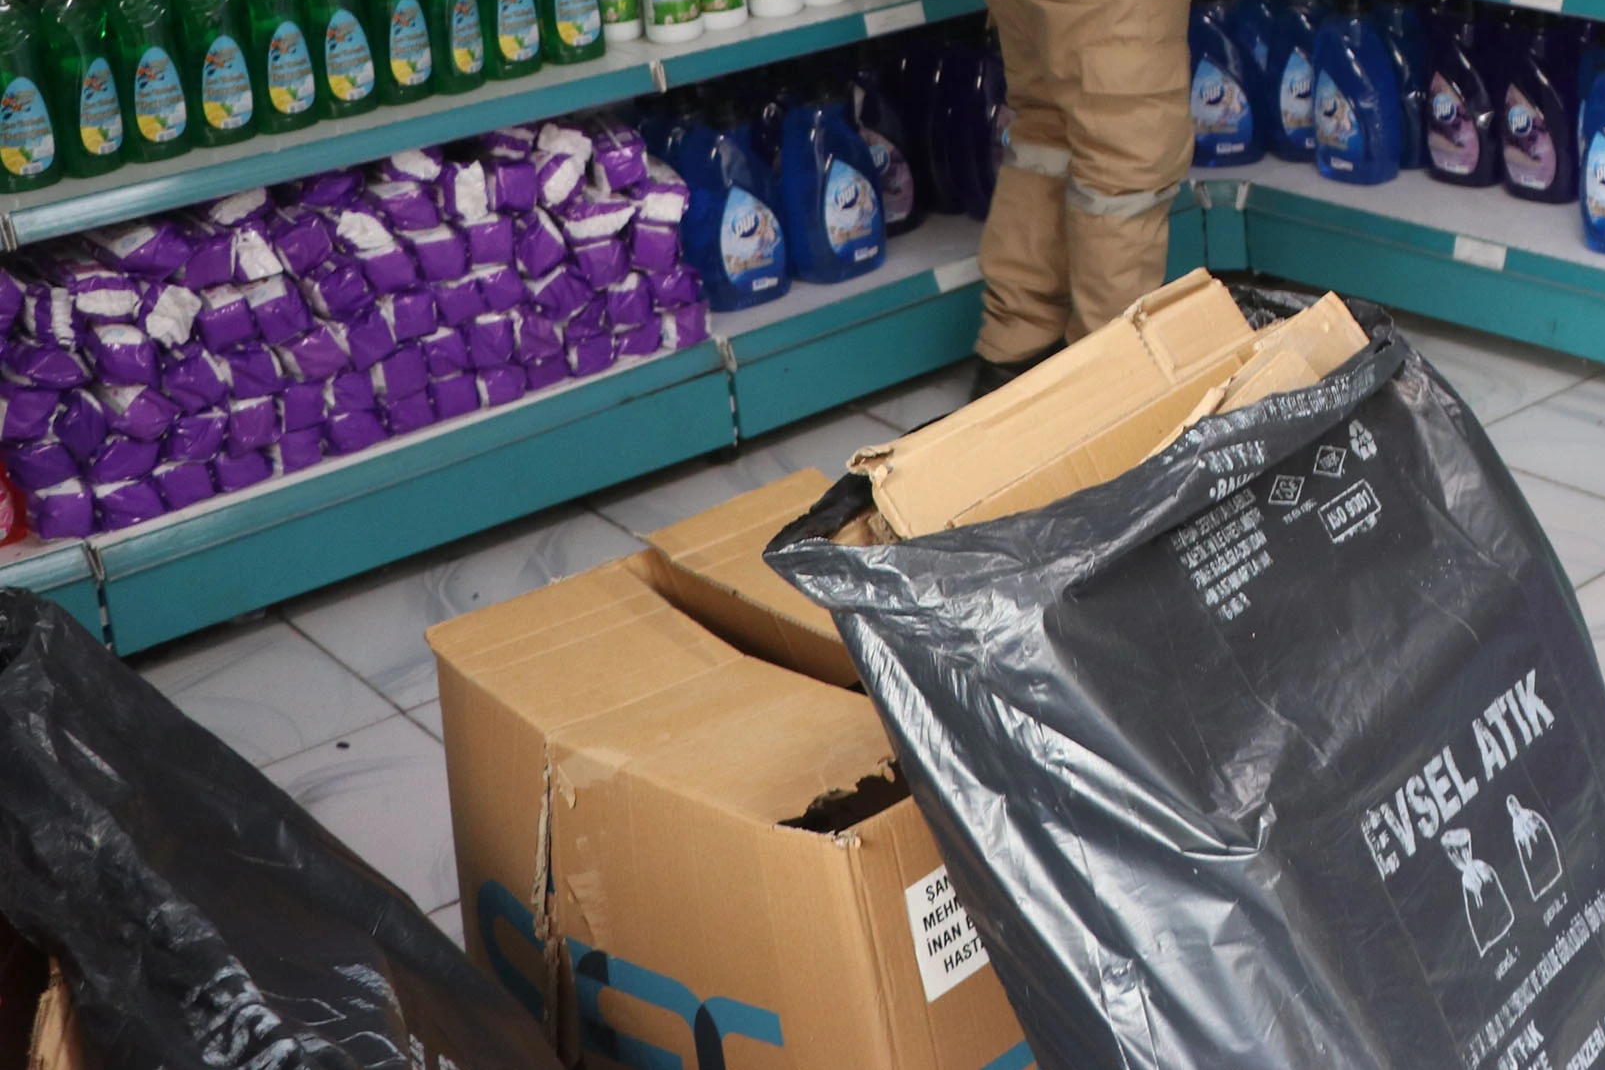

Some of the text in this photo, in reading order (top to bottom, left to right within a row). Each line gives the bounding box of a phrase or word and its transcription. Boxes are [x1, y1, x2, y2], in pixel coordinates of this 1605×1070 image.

[1327, 508, 1347, 530] ISO
[1361, 669, 1555, 881] EVSEL ATIK
[928, 924, 962, 957] İNAN
[1498, 1019, 1545, 1070] UTFAK
